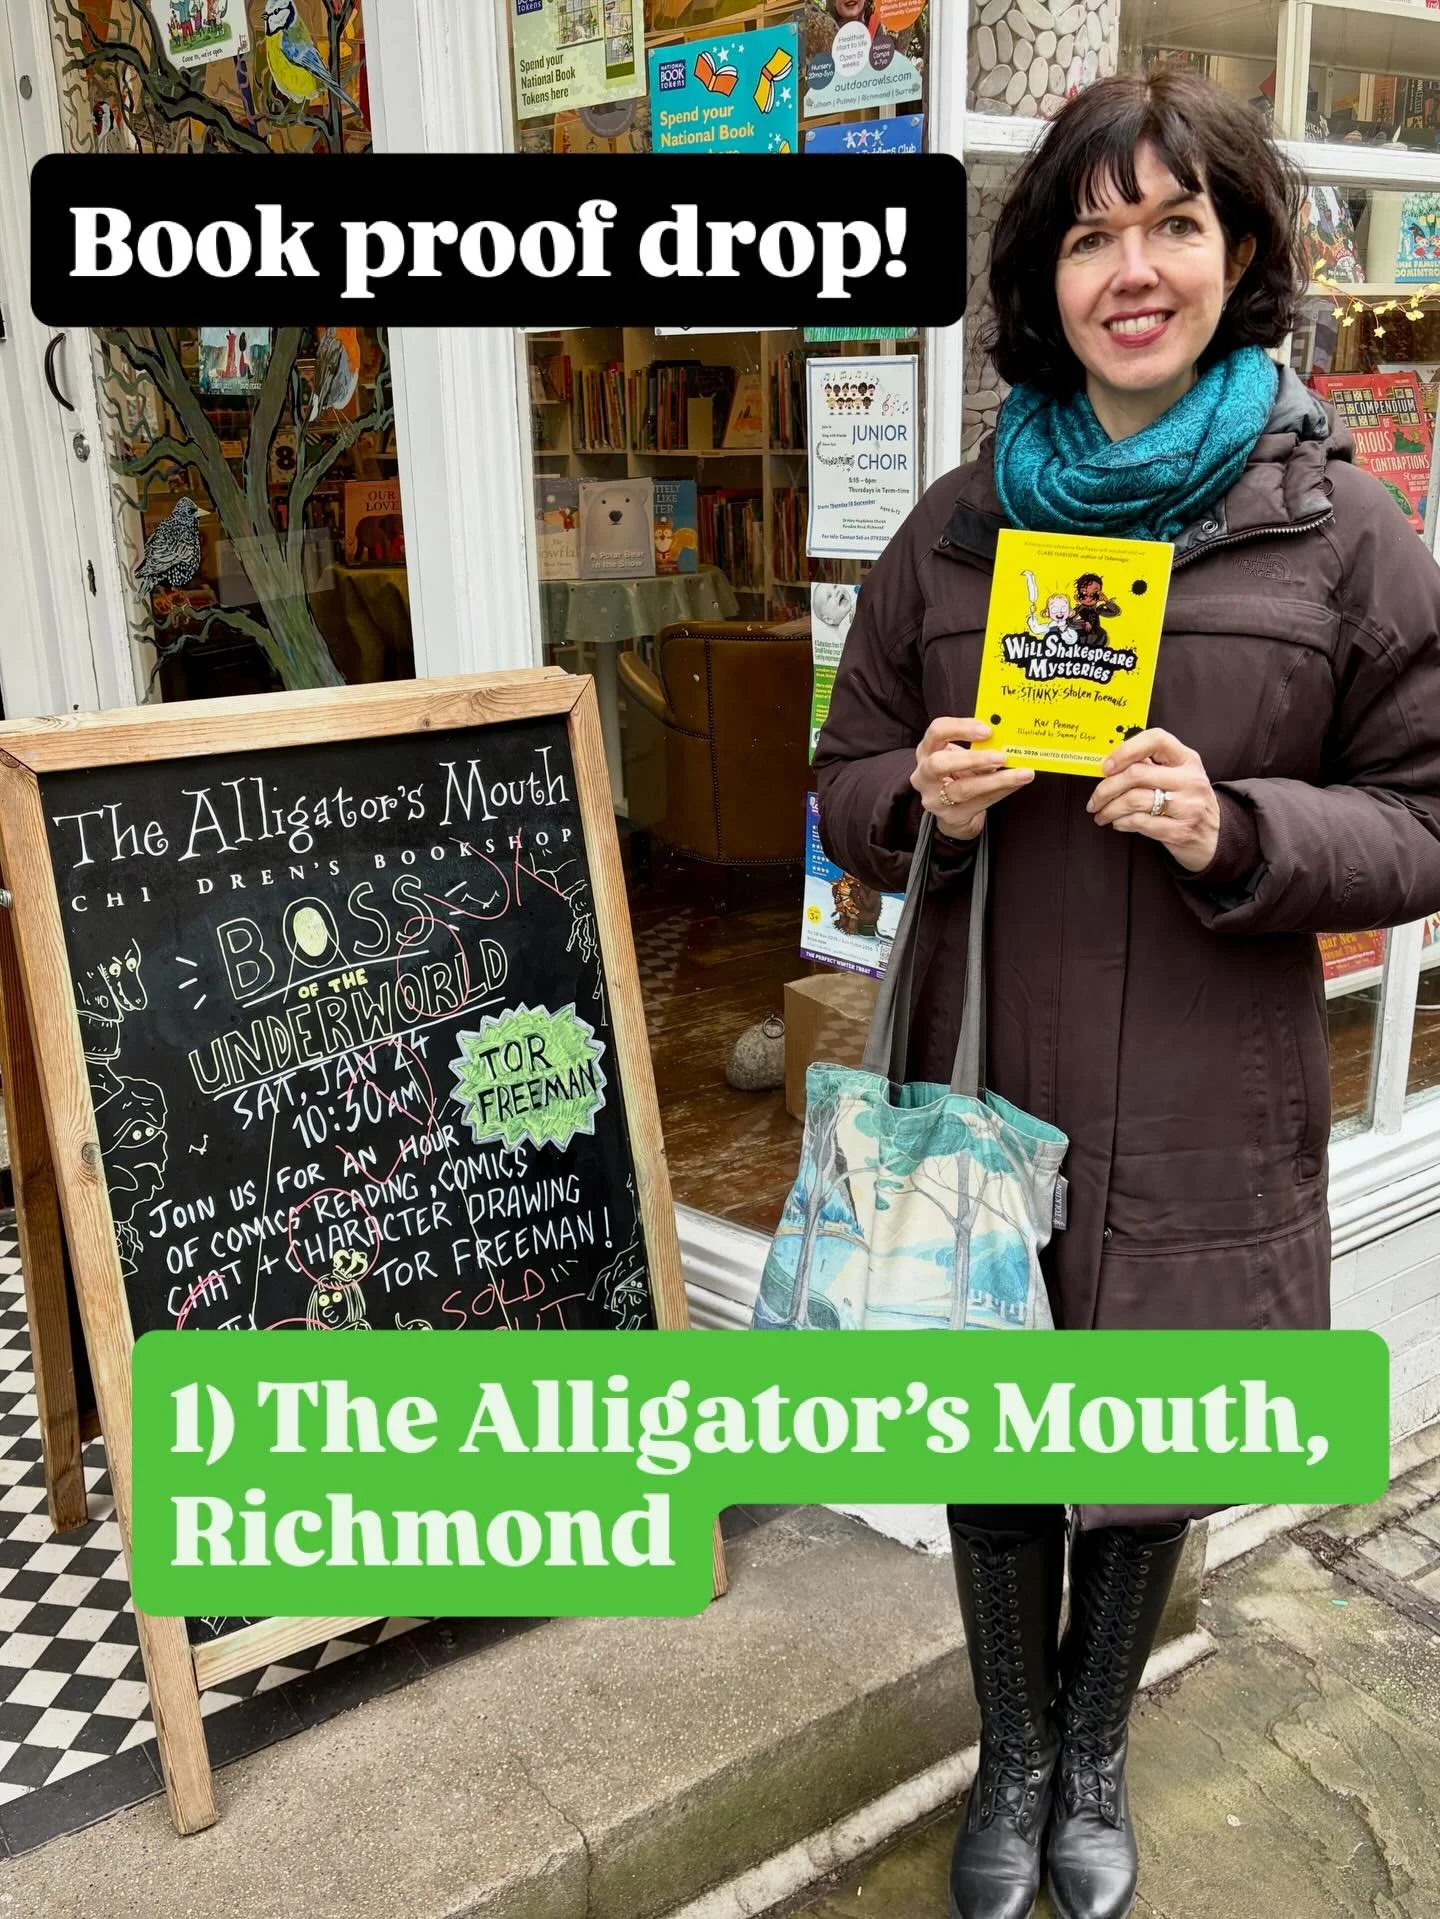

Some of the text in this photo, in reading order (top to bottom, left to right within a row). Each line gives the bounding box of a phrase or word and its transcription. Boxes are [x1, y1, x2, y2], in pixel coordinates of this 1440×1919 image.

[836, 39, 868, 51] start to life
[838, 33, 865, 43] Healthier
[520, 54, 564, 74] Spend your
[839, 53, 857, 63] Open
[842, 61, 860, 69] weeks
[872, 51, 890, 61] Camps
[660, 62, 685, 71] NATIONAL
[811, 63, 832, 72] Nursery
[521, 66, 576, 90] National Book
[660, 69, 685, 83] BOOK
[834, 71, 912, 93] outdoorowls.com
[522, 87, 569, 106] Tokens here
[861, 92, 891, 102] Richmond
[660, 105, 734, 129] Spend your
[660, 121, 755, 148] National Book
[898, 144, 917, 154] Club
[1354, 399, 1416, 416] COMPENDIUM
[852, 425, 907, 445] JUNIOR
[857, 453, 908, 471] CHOIR
[1370, 455, 1430, 473] CONTRAPTIONS
[848, 486, 874, 494] Thursdays
[865, 477, 877, 485] 6pm
[368, 489, 395, 501] OUR
[656, 494, 678, 503] LIKE
[366, 500, 400, 512] LOVE
[655, 504, 674, 513] TER
[591, 559, 643, 569] in the Snow
[599, 551, 622, 560] Polar
[624, 551, 644, 560] Bear
[1001, 684, 1127, 707] The STINKY Stolen Toenails
[1017, 728, 1046, 737] Illustrated
[1053, 719, 1080, 732] Penney
[1023, 749, 1039, 757] 2026
[52, 745, 571, 868] The Alligator's Mouth
[374, 828, 572, 869] BOOKSHOP
[216, 874, 435, 1000] BOSS
[805, 951, 815, 959] THE
[815, 953, 836, 964] PERFECT
[836, 960, 855, 970] WINTER
[855, 965, 871, 974] TREAT
[297, 967, 369, 999] OF THE
[188, 938, 508, 1094] UNDERWORLD
[479, 1032, 552, 1084] TOR
[232, 1072, 308, 1131] SAT,
[309, 1046, 377, 1096] JAN
[475, 1062, 600, 1125] FREEMAN
[149, 1125, 460, 1238] JOIN US FOR AN HOUR
[166, 1236, 200, 1274] OF
[210, 1206, 301, 1258] COMICS
[313, 1172, 419, 1223] READING
[167, 1259, 242, 1317] CHAT
[285, 1201, 453, 1273] CHARACTER
[468, 1174, 580, 1225] DRAWING
[373, 1250, 438, 1293] TOR
[442, 1269, 546, 1330] SOLD
